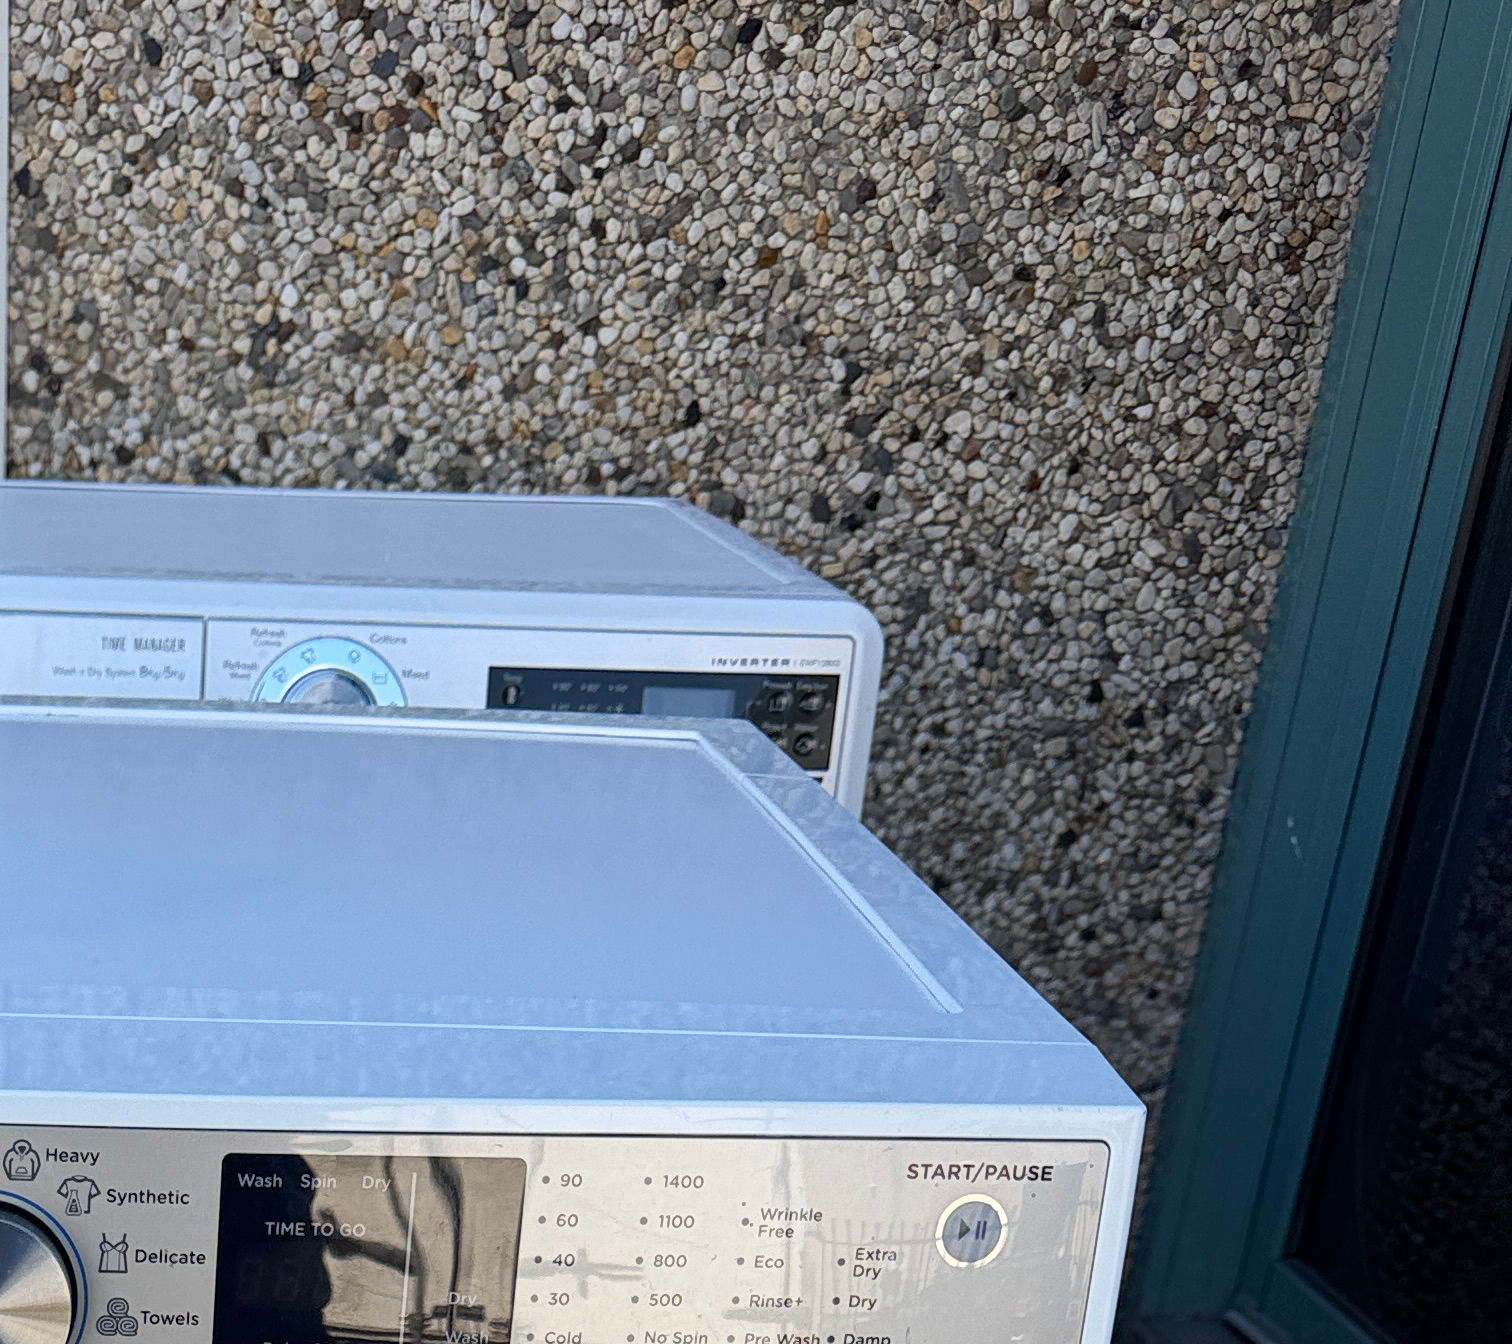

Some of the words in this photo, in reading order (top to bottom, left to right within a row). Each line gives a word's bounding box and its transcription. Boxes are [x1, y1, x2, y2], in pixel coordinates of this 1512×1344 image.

[45, 1147, 100, 1167] Heavy
[560, 1173, 583, 1188] 90
[906, 1163, 1054, 1183] START/PAUSE
[238, 1174, 282, 1188] Wash
[300, 1174, 337, 1191] Spin
[362, 1176, 390, 1191] Dry
[663, 1174, 705, 1189] 1400
[106, 1188, 190, 1208] Synthetic
[556, 1213, 579, 1228] 60
[658, 1214, 695, 1229] 1100
[760, 1207, 823, 1224] Wrinkle
[265, 1222, 305, 1236] TIME
[312, 1223, 334, 1236] TO
[340, 1224, 366, 1236] GO
[758, 1224, 795, 1239] Free
[134, 1248, 207, 1266] Delicate
[551, 1254, 575, 1268] 40
[653, 1254, 688, 1269] 800
[754, 1255, 784, 1270] Eco
[854, 1247, 897, 1263] Extra
[852, 1264, 882, 1281] Dry
[448, 1292, 477, 1307] Dry
[547, 1292, 570, 1307] 30
[648, 1292, 683, 1307] 500
[749, 1293, 804, 1309] Rinse+
[848, 1294, 878, 1312] Dry
[141, 1310, 200, 1326] Towels
[445, 1332, 489, 1344] Wash
